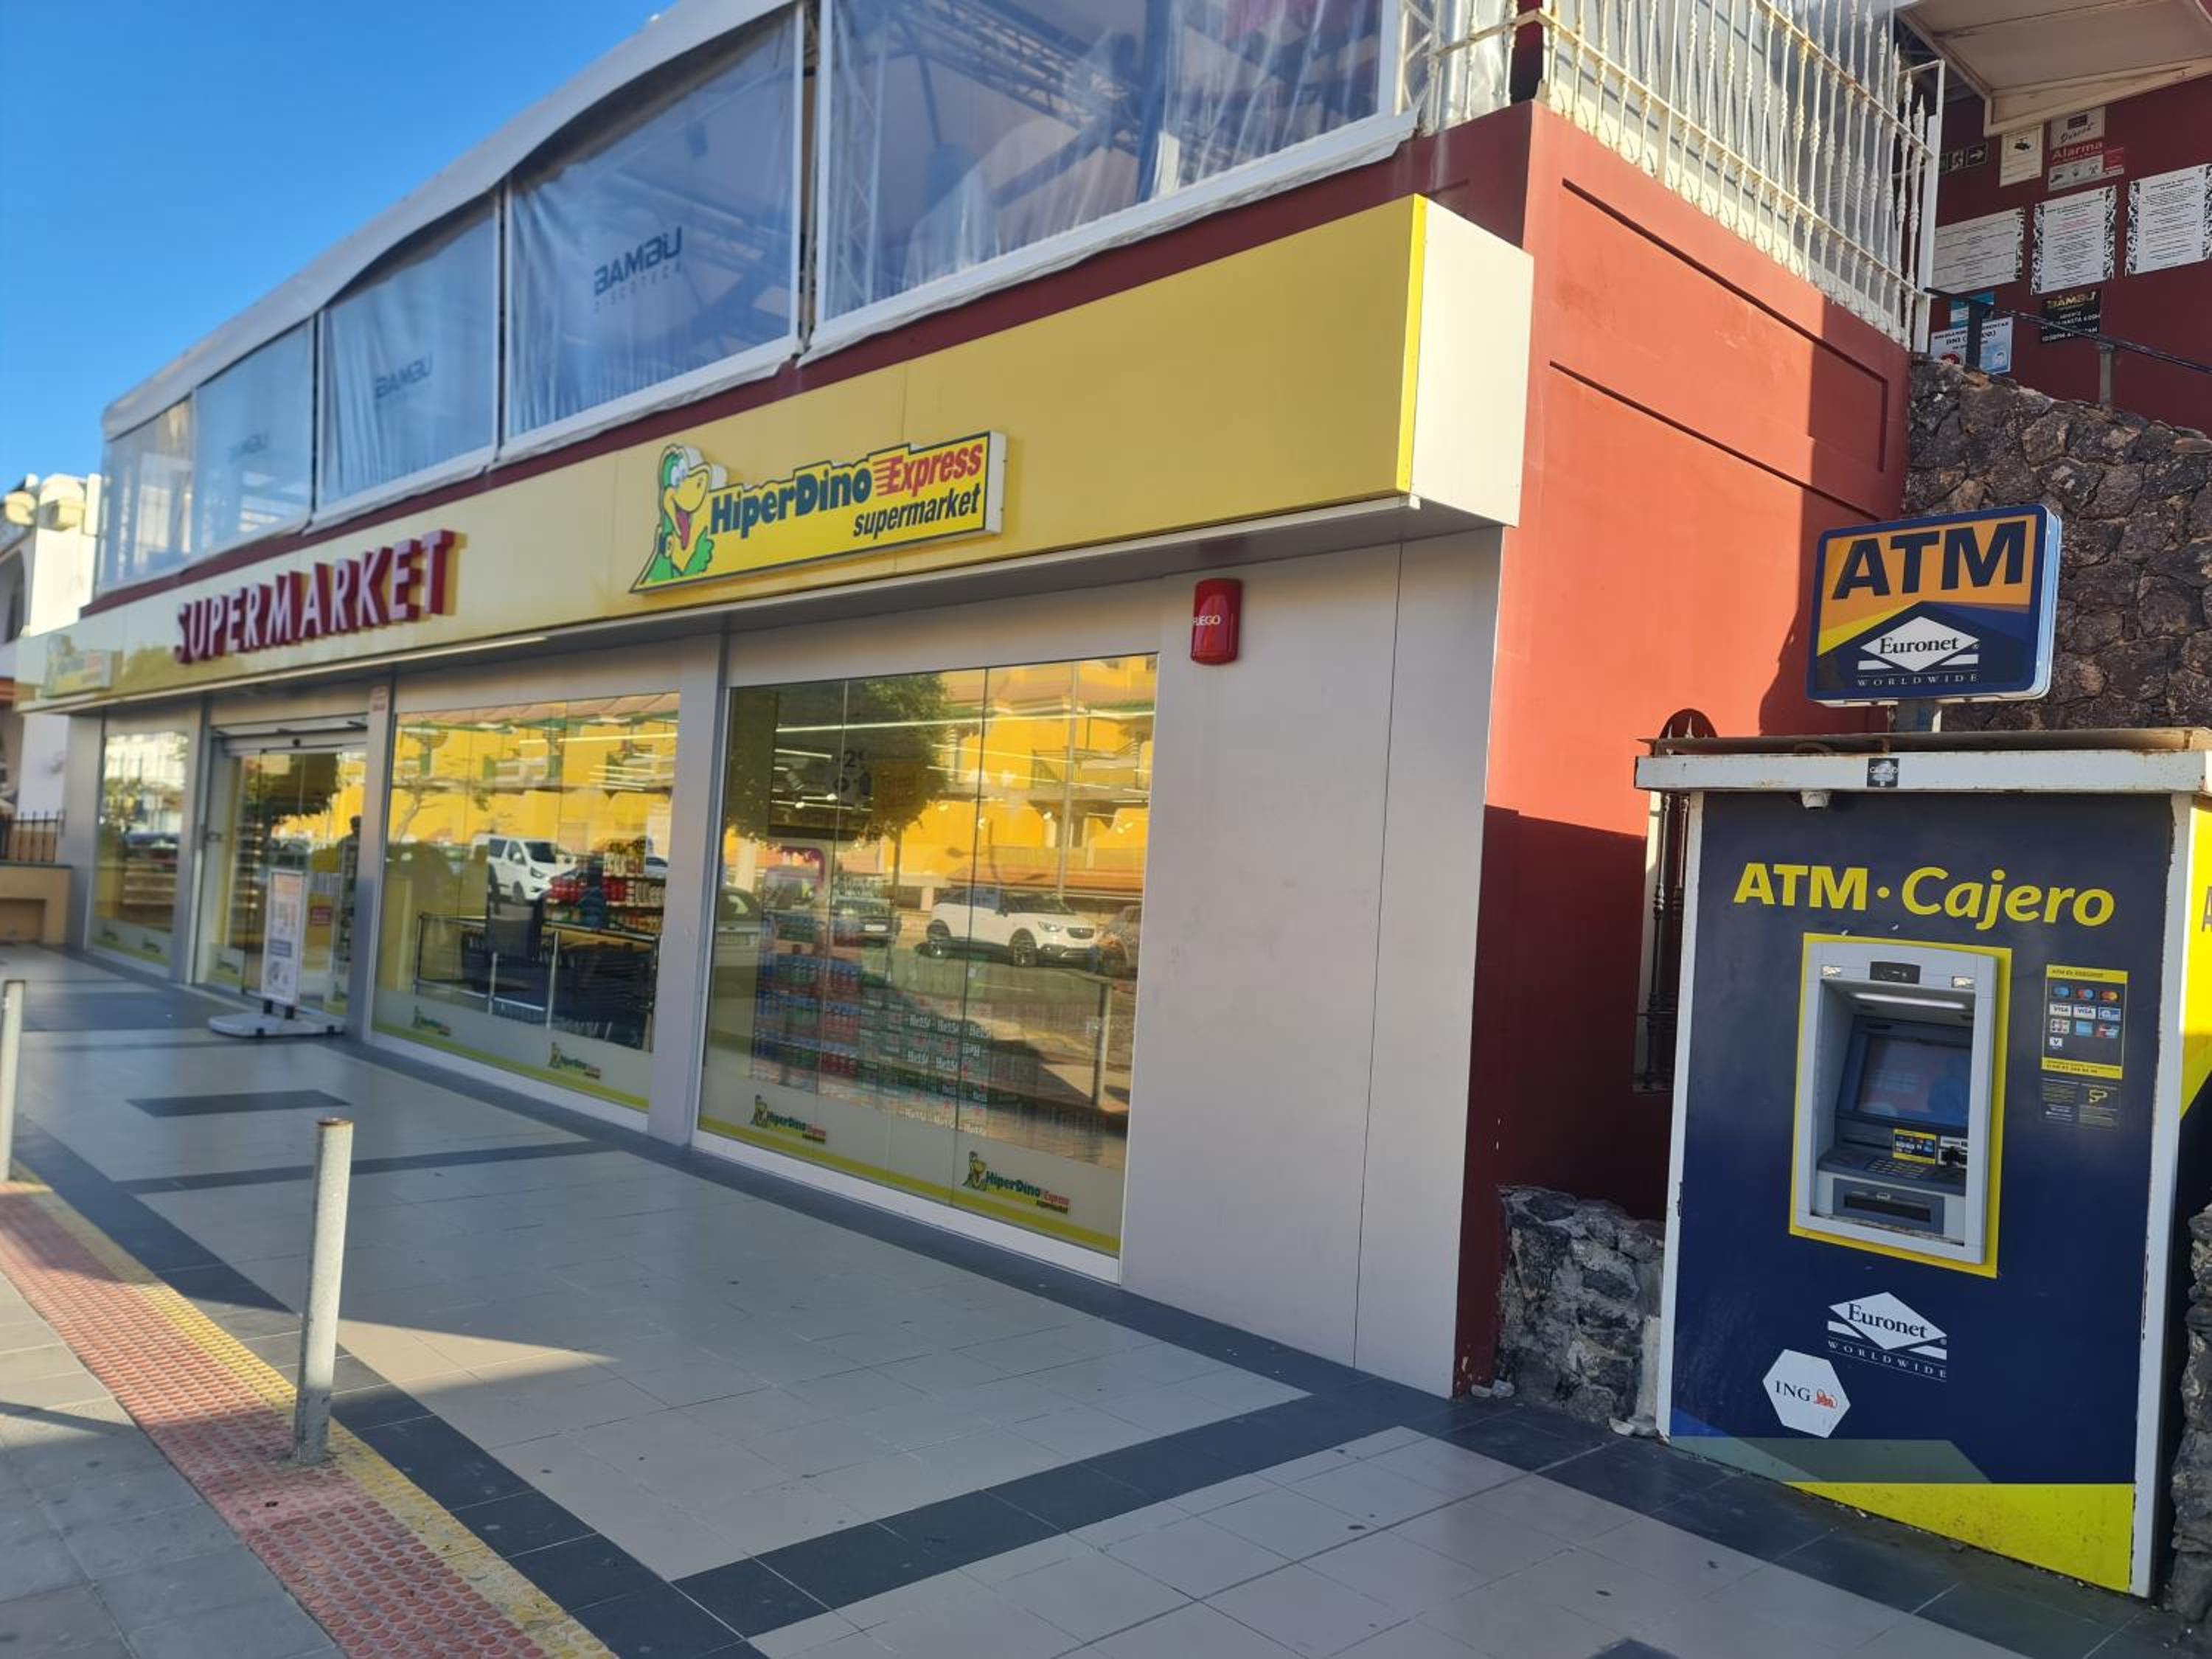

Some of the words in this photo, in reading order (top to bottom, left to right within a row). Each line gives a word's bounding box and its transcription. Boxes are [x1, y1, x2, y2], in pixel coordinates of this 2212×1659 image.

[710, 466, 872, 538] HiperDino
[885, 443, 983, 495] Express
[853, 483, 980, 539] supermarket
[1832, 521, 2028, 600] ATM
[173, 529, 456, 664] SUPERMARKET
[1879, 633, 1961, 655] Euronet
[1857, 672, 1979, 687] WORLDWIDE
[1733, 863, 1868, 911] ATM
[1902, 866, 2116, 931] Cajero
[1847, 1302, 1927, 1339] Euronet
[1828, 1340, 1947, 1379] WORLDWIDE
[1775, 1380, 1811, 1402] ING
